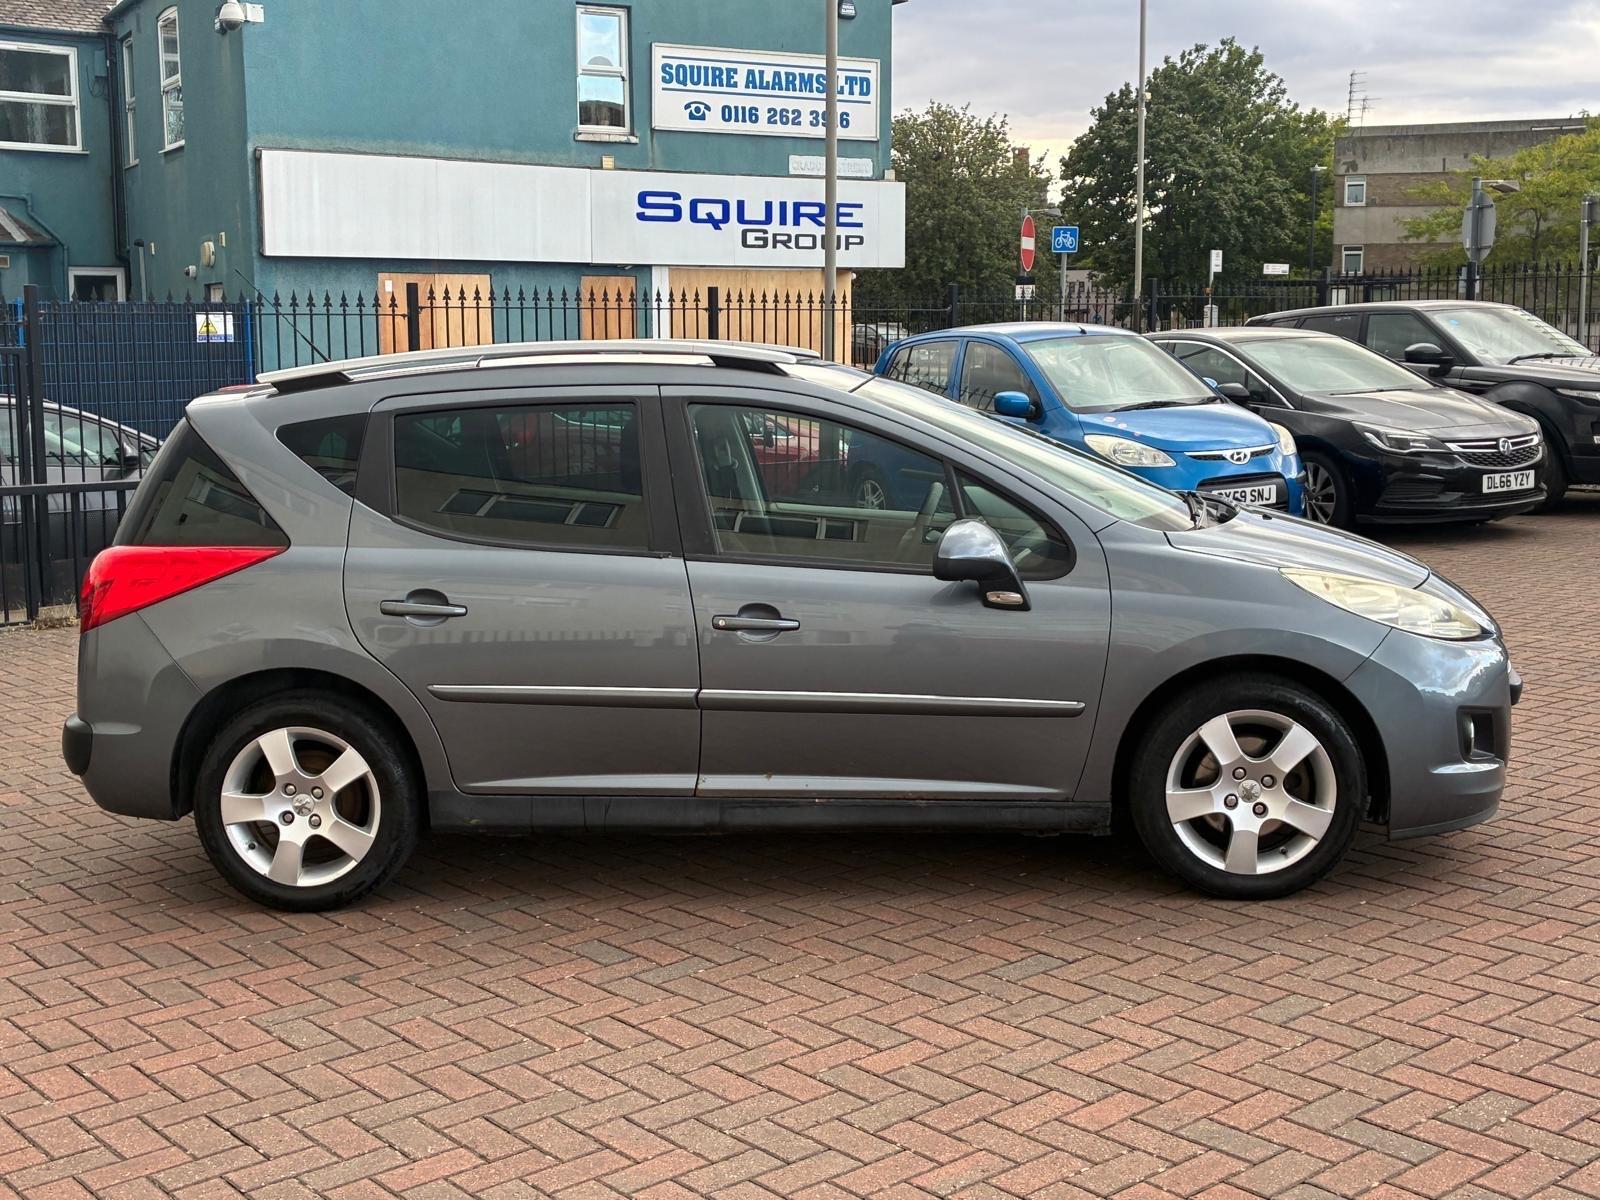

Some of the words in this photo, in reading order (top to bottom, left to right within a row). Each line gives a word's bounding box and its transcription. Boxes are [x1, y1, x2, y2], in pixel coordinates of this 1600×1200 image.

[661, 63, 738, 88] SQUIRE
[744, 69, 827, 94] ALARMS
[836, 75, 871, 97] LTD
[721, 105, 759, 124] 0116
[767, 108, 801, 126] 262
[809, 110, 850, 129] 396
[636, 191, 863, 230] SQUIRE
[1487, 474, 1512, 490] DL66
[1514, 471, 1531, 487] YZY
[1250, 487, 1272, 502] SNJ
